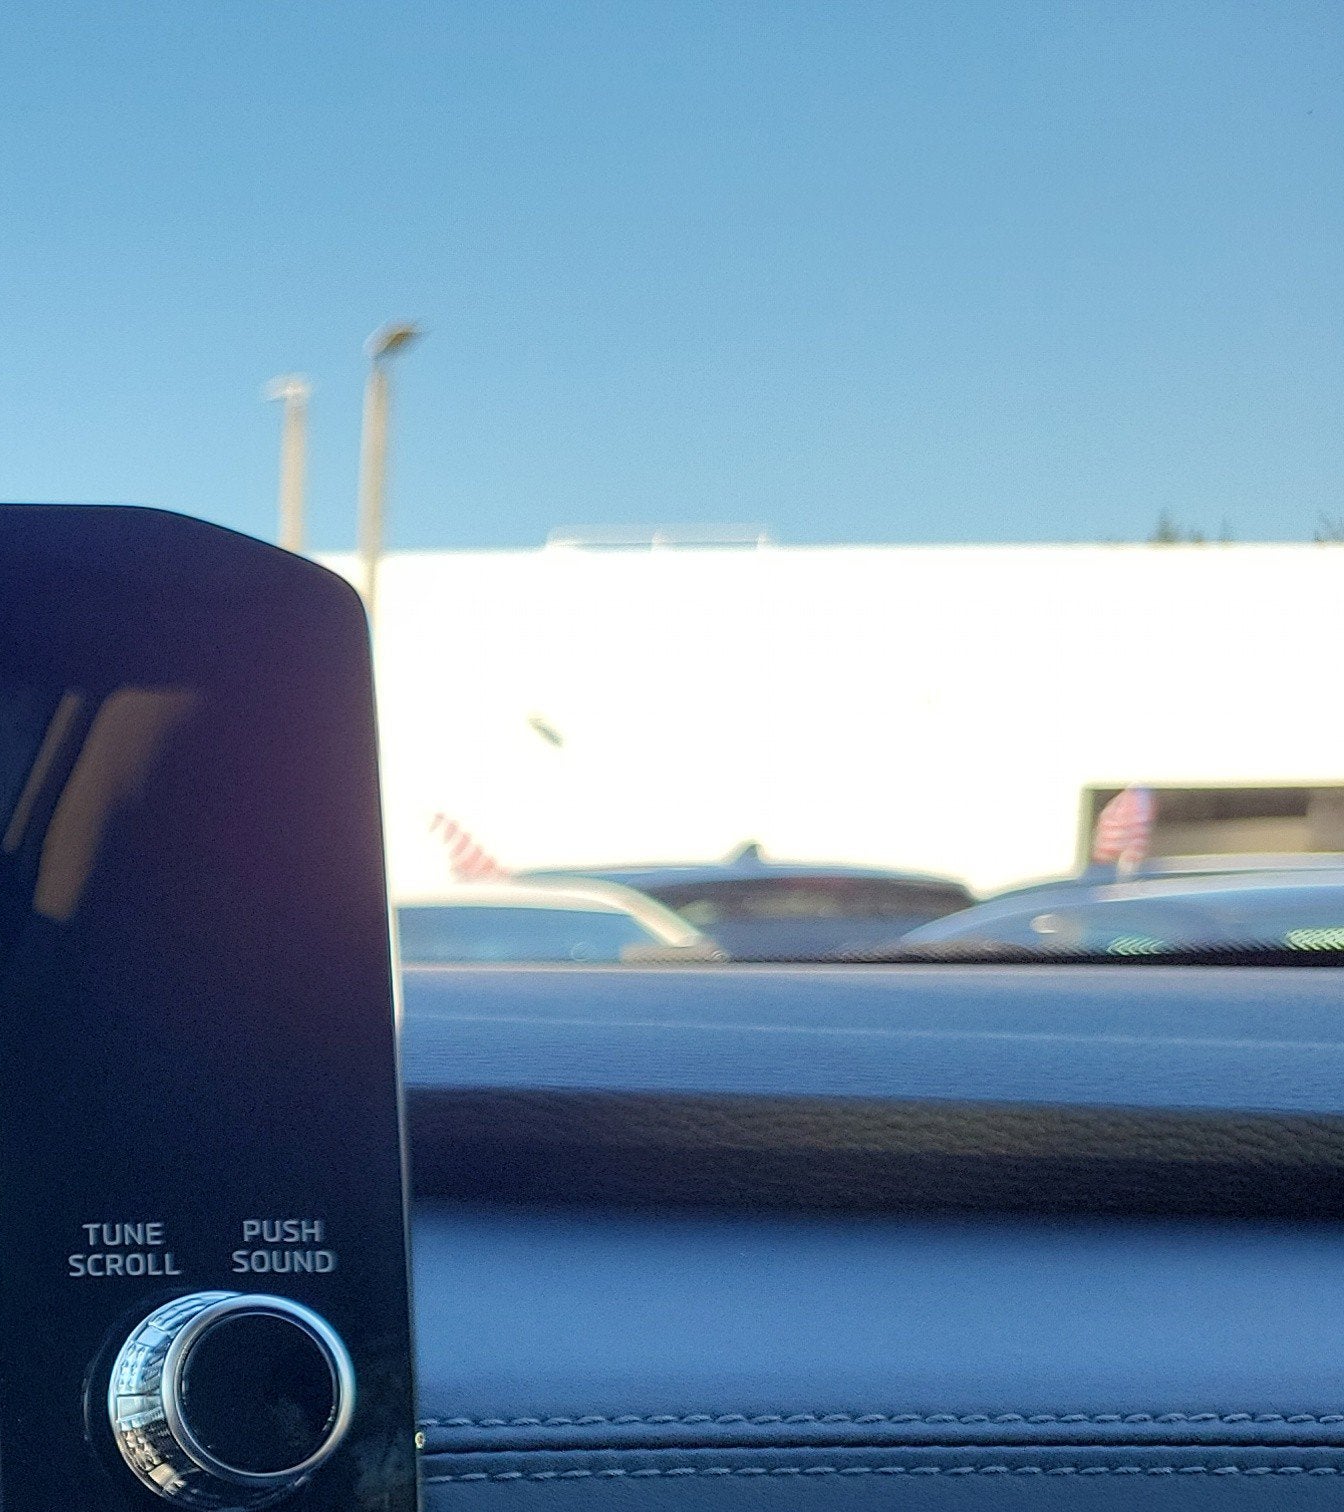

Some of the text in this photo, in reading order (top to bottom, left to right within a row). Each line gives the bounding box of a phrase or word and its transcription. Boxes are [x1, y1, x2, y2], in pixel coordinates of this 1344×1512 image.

[82, 1222, 163, 1246] TUNE
[242, 1220, 323, 1243] PUSH
[68, 1253, 181, 1277] SCROLL
[231, 1251, 335, 1274] SOUND
